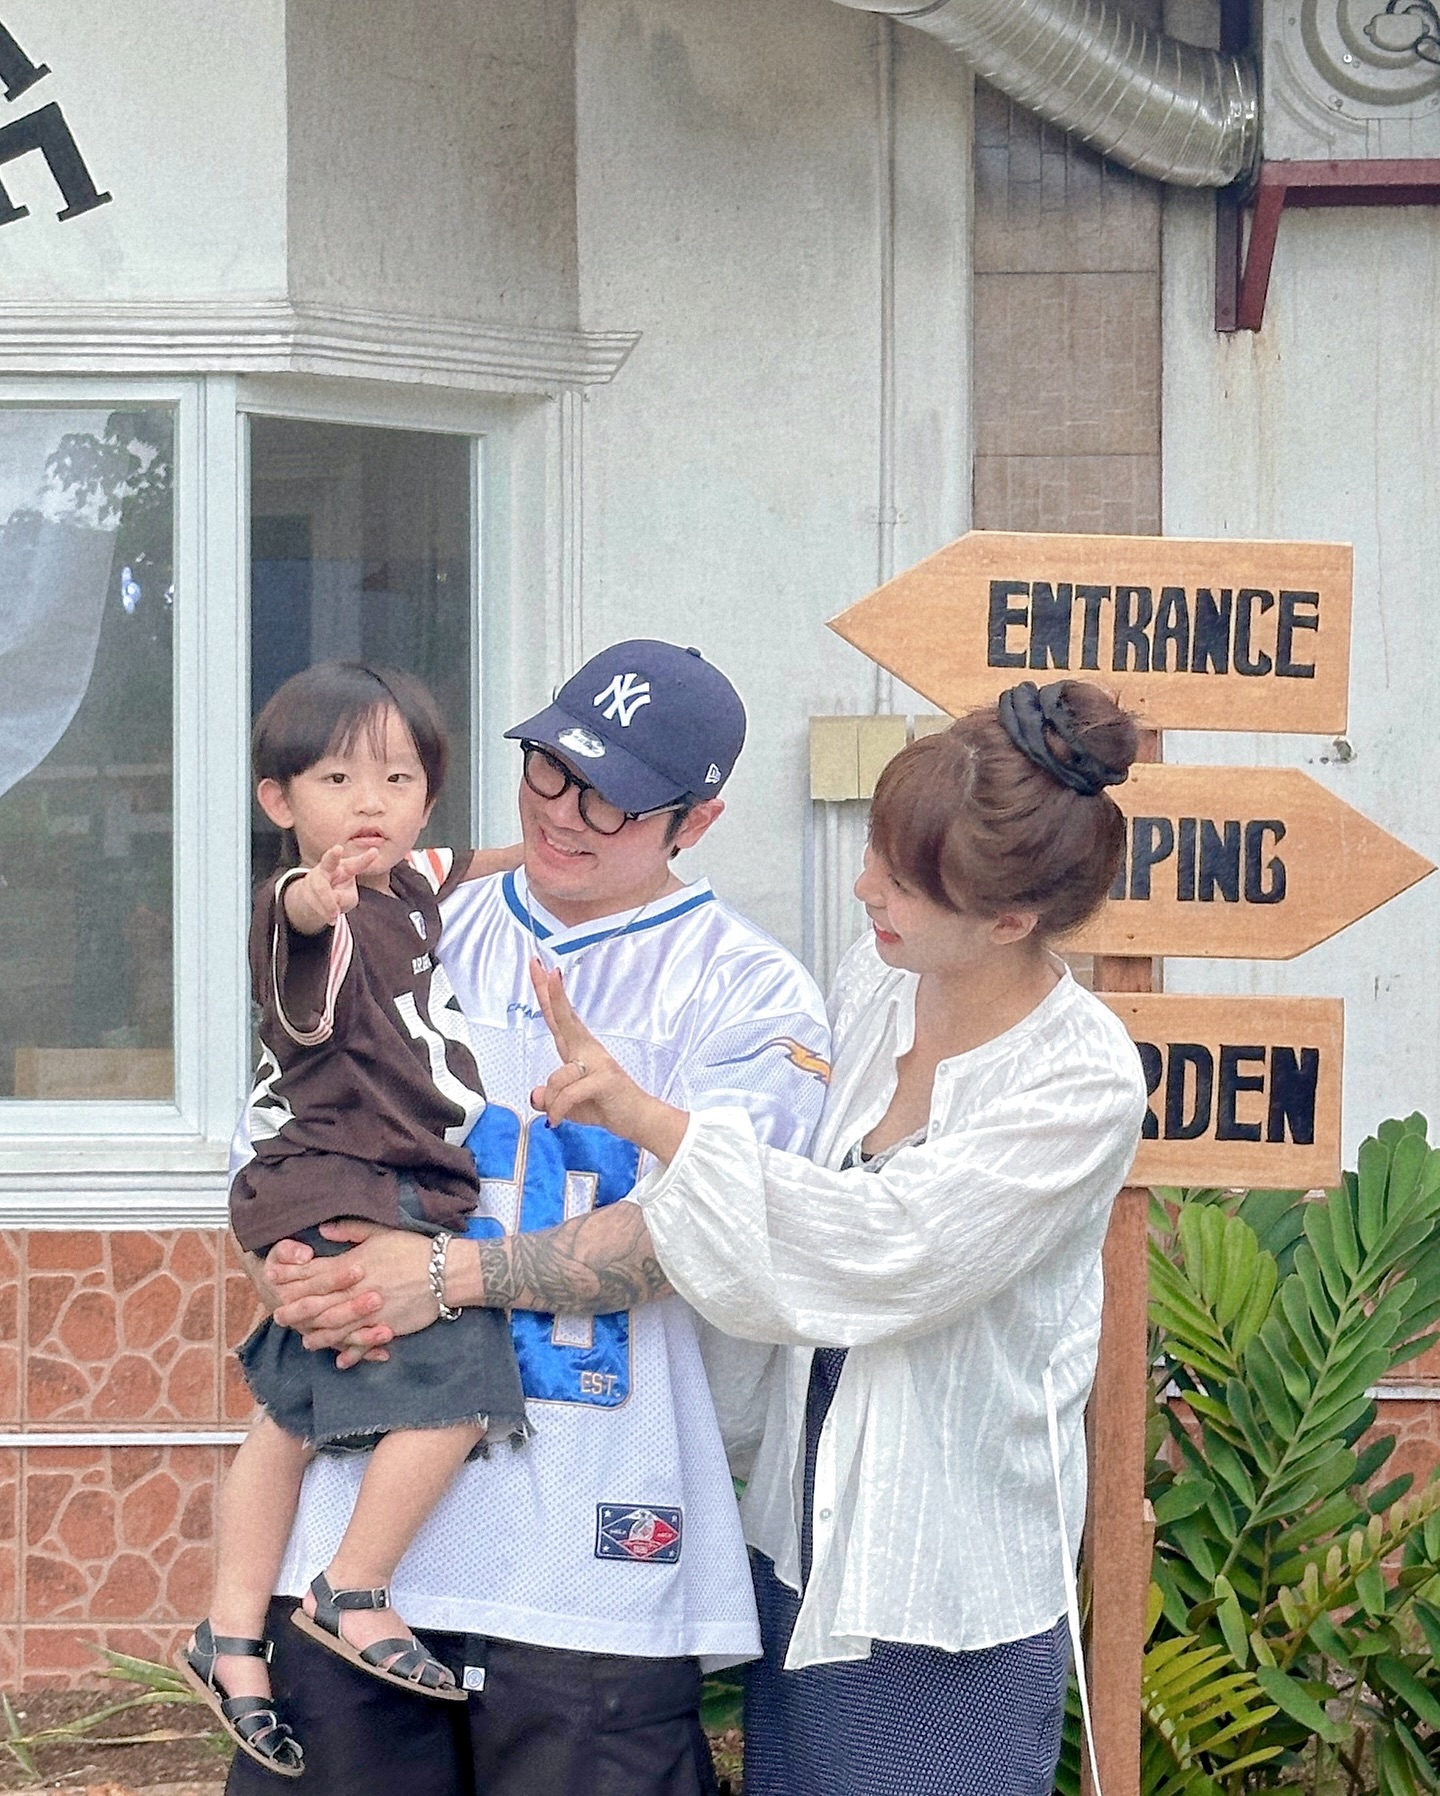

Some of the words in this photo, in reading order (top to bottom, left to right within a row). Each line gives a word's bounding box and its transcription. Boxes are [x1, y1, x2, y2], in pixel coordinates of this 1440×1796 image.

[987, 580, 1320, 679] ENTRANCE
[1108, 817, 1287, 904] PING
[581, 1371, 621, 1397] EST.
